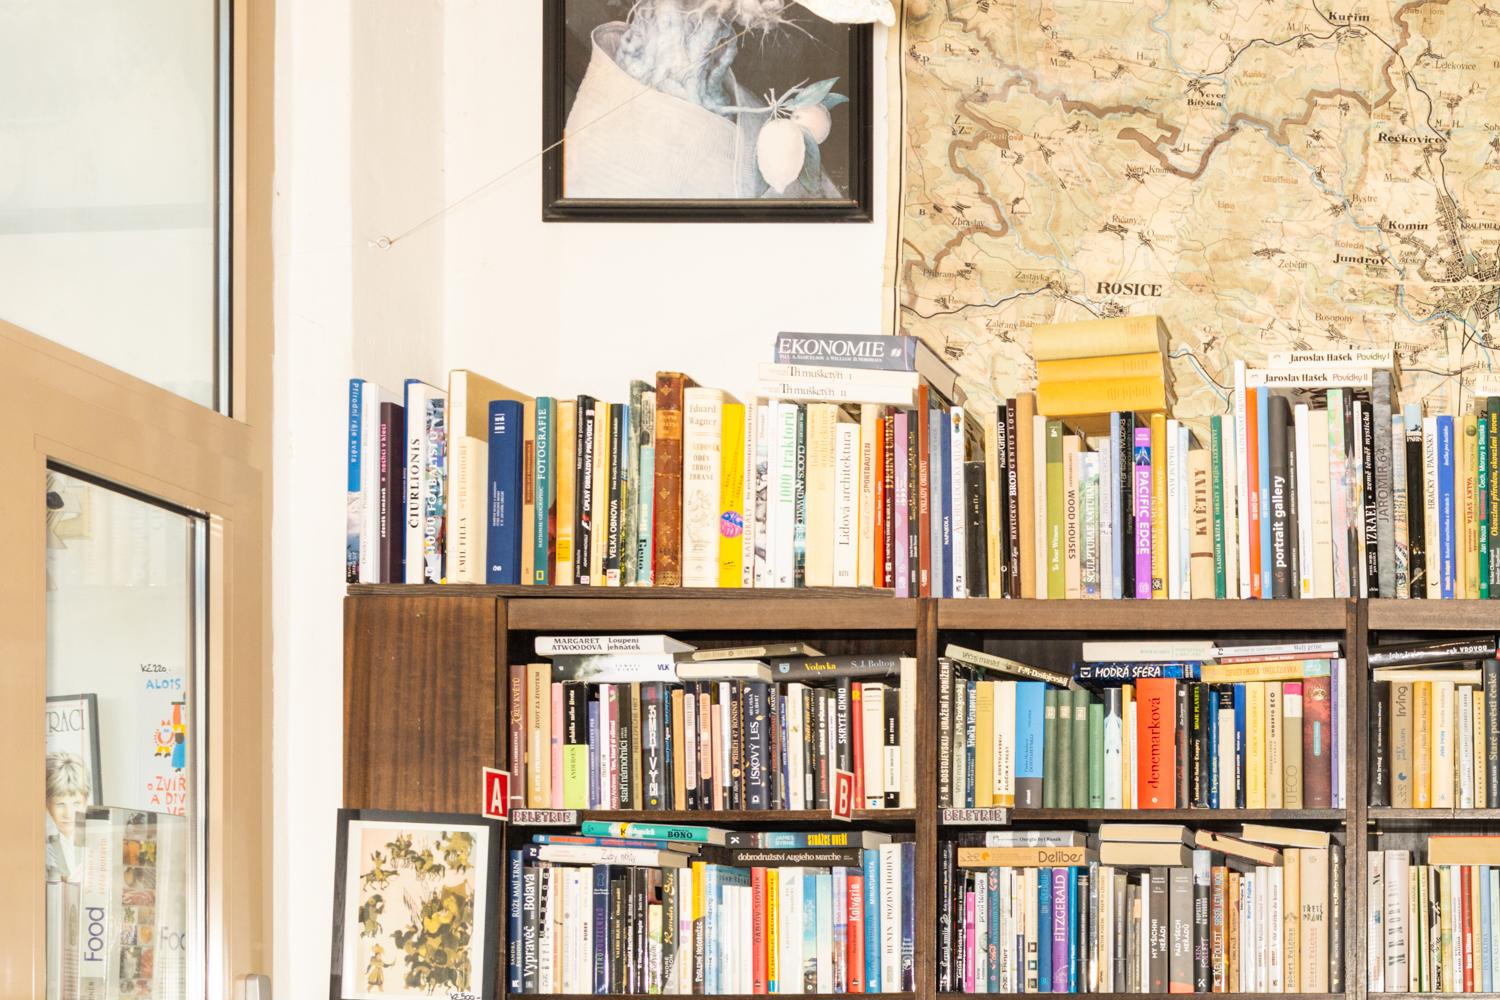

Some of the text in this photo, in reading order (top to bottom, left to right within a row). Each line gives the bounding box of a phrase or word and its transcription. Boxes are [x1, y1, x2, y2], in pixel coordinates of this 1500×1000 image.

[1096, 281, 1162, 297] ROSICE
[779, 338, 884, 358] EKONOMIE
[1290, 352, 1324, 364] Jaroslav
[1326, 352, 1353, 363] Hašek
[1356, 352, 1385, 362] Povídky
[538, 408, 547, 479] FOTOGRAFIE
[839, 431, 852, 546] Lidová architektura
[1139, 471, 1149, 554] PACIFIC EDGE
[1273, 476, 1285, 568] portrait gallery
[552, 643, 602, 651] ATWOODOVÁ
[805, 662, 836, 671] Volavka
[1095, 665, 1161, 678] MODRÁ SFÉRA
[146, 679, 181, 690] ALOIS
[1489, 672, 1498, 760] Staré pověsti české
[751, 722, 760, 786] LÍSKOVÝ LES
[1150, 696, 1161, 790] denemarková
[489, 775, 504, 814] A
[837, 778, 849, 816] B
[513, 810, 572, 823] BELETRIE
[668, 831, 693, 839] BONO
[738, 854, 784, 862] dobrodružství
[786, 854, 814, 862] Augieho
[1039, 851, 1082, 862] Delibes
[1054, 874, 1064, 941] FITZGERALD
[84, 907, 105, 963] Food
[524, 925, 534, 977] Vypravěč
[1152, 949, 1158, 959] MY
